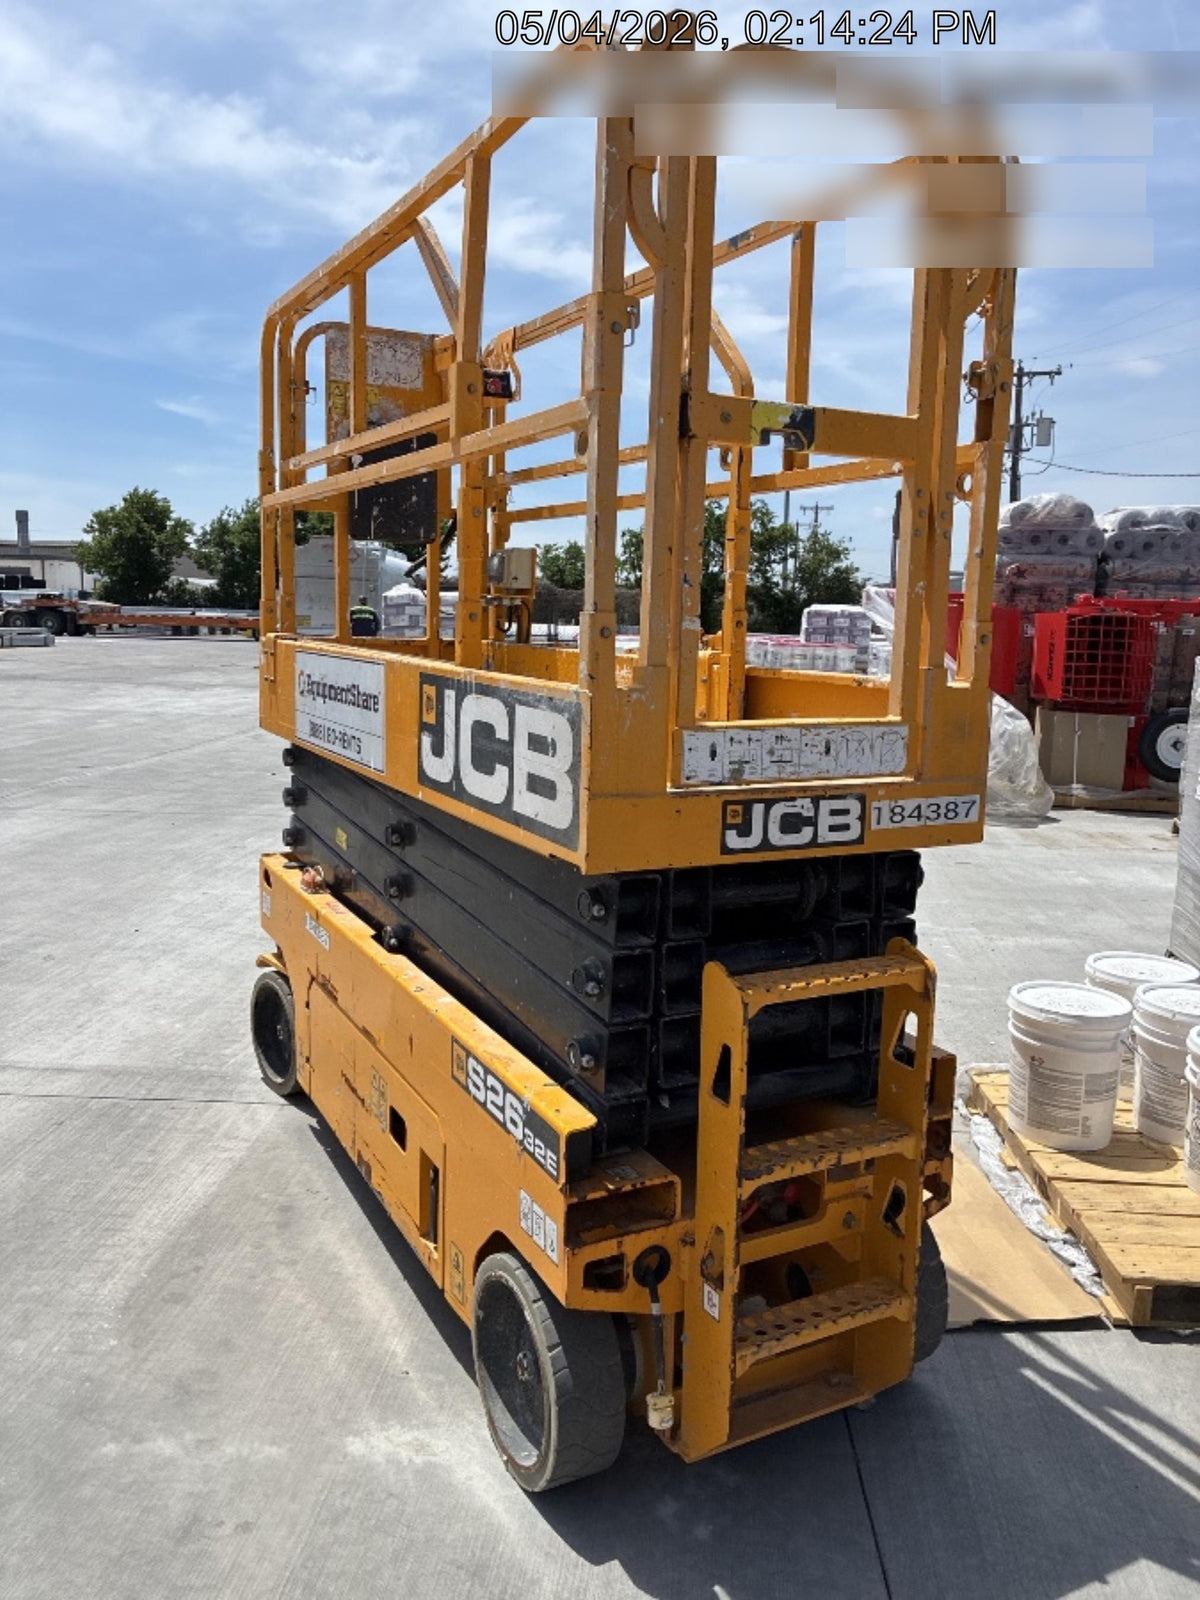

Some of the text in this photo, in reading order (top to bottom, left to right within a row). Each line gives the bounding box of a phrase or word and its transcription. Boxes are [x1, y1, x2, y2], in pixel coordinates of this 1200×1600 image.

[420, 688, 574, 830] JCB
[725, 797, 977, 849] JCB 184387
